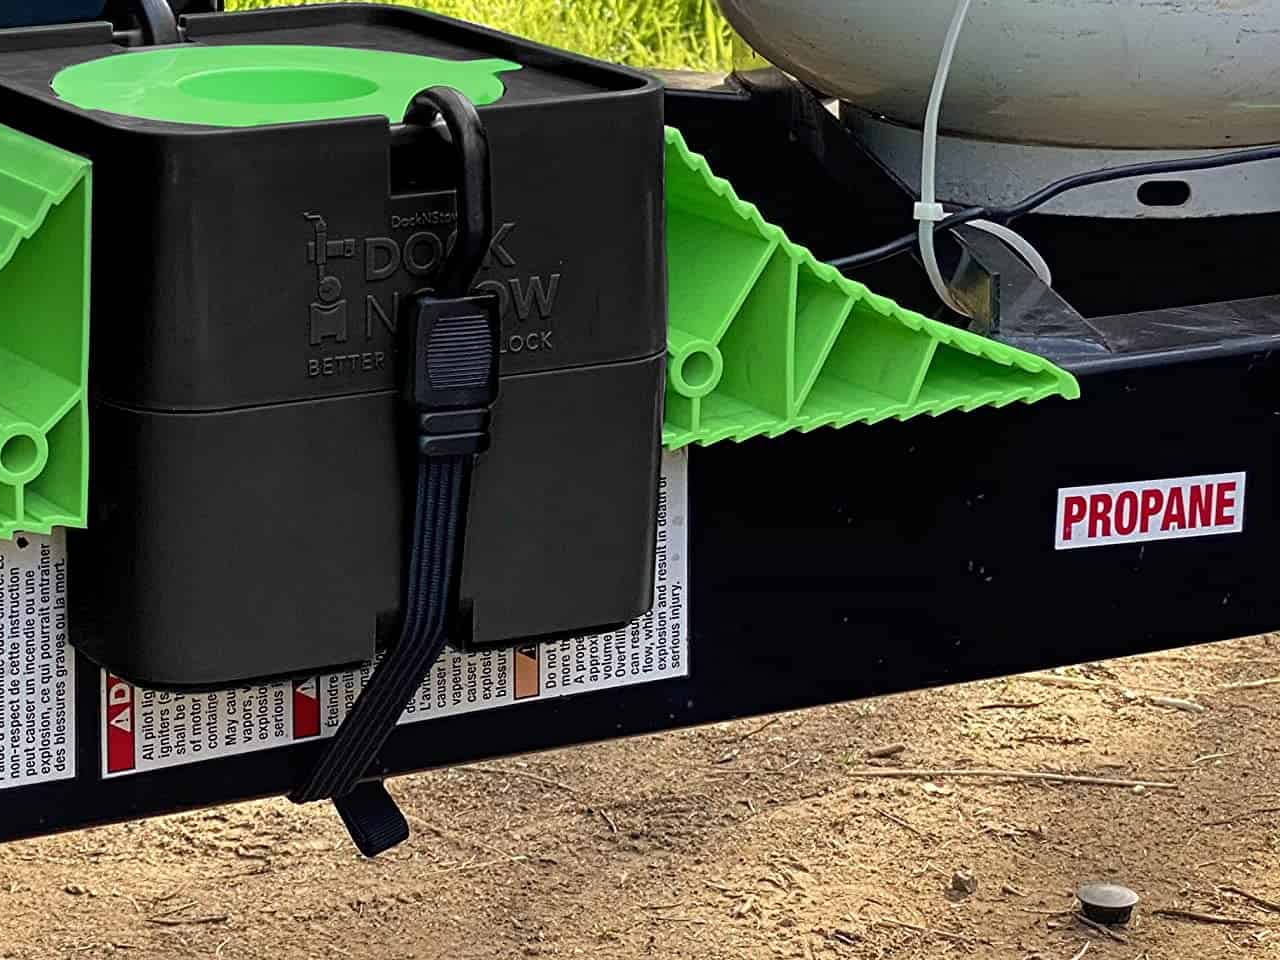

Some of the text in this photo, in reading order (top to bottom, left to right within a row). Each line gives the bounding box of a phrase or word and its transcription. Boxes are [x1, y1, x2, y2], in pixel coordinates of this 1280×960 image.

[308, 352, 385, 378] BETTER
[1062, 481, 1236, 541] PROPANE
[654, 545, 668, 670] explosion and result
[669, 582, 682, 669] serious injury.
[545, 648, 556, 689] Do not
[561, 655, 570, 687] more
[599, 634, 612, 680] volume
[630, 653, 639, 675] can
[642, 643, 654, 673] flow,
[189, 698, 201, 752] of motor
[242, 696, 254, 743] vapors,
[274, 690, 284, 737] serious
[324, 675, 338, 728] Éteindre
[141, 711, 156, 761] All pilot
[158, 709, 172, 758] igniters
[173, 704, 186, 755] shall be
[224, 720, 238, 746] May
